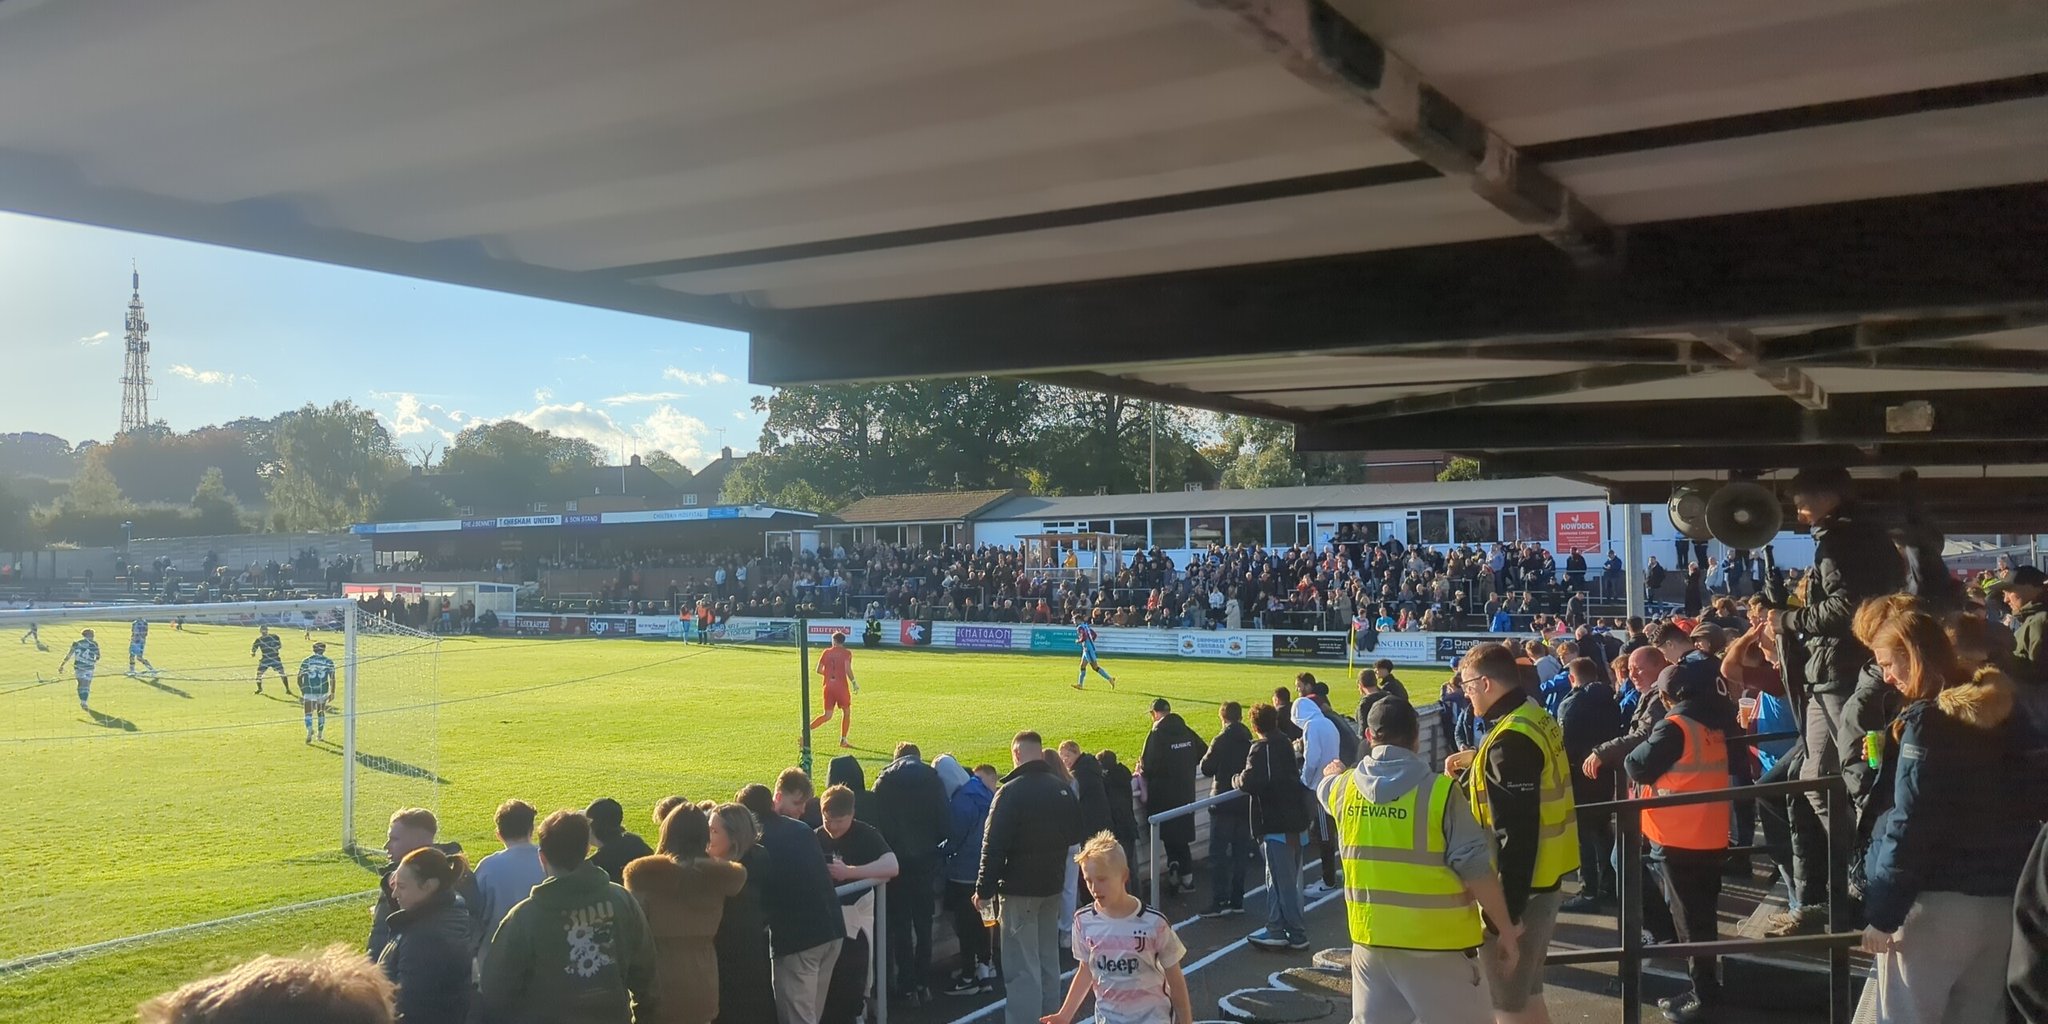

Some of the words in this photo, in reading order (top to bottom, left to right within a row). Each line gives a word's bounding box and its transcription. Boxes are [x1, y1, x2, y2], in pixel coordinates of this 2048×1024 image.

[503, 517, 531, 526] CHESHAM
[533, 516, 555, 525] UNITED
[1560, 522, 1595, 530] HOWDENS
[589, 618, 609, 635] sign
[1376, 640, 1425, 648] NCHESTER
[1347, 805, 1407, 820] STEWARD
[1097, 954, 1140, 975] Jeep
